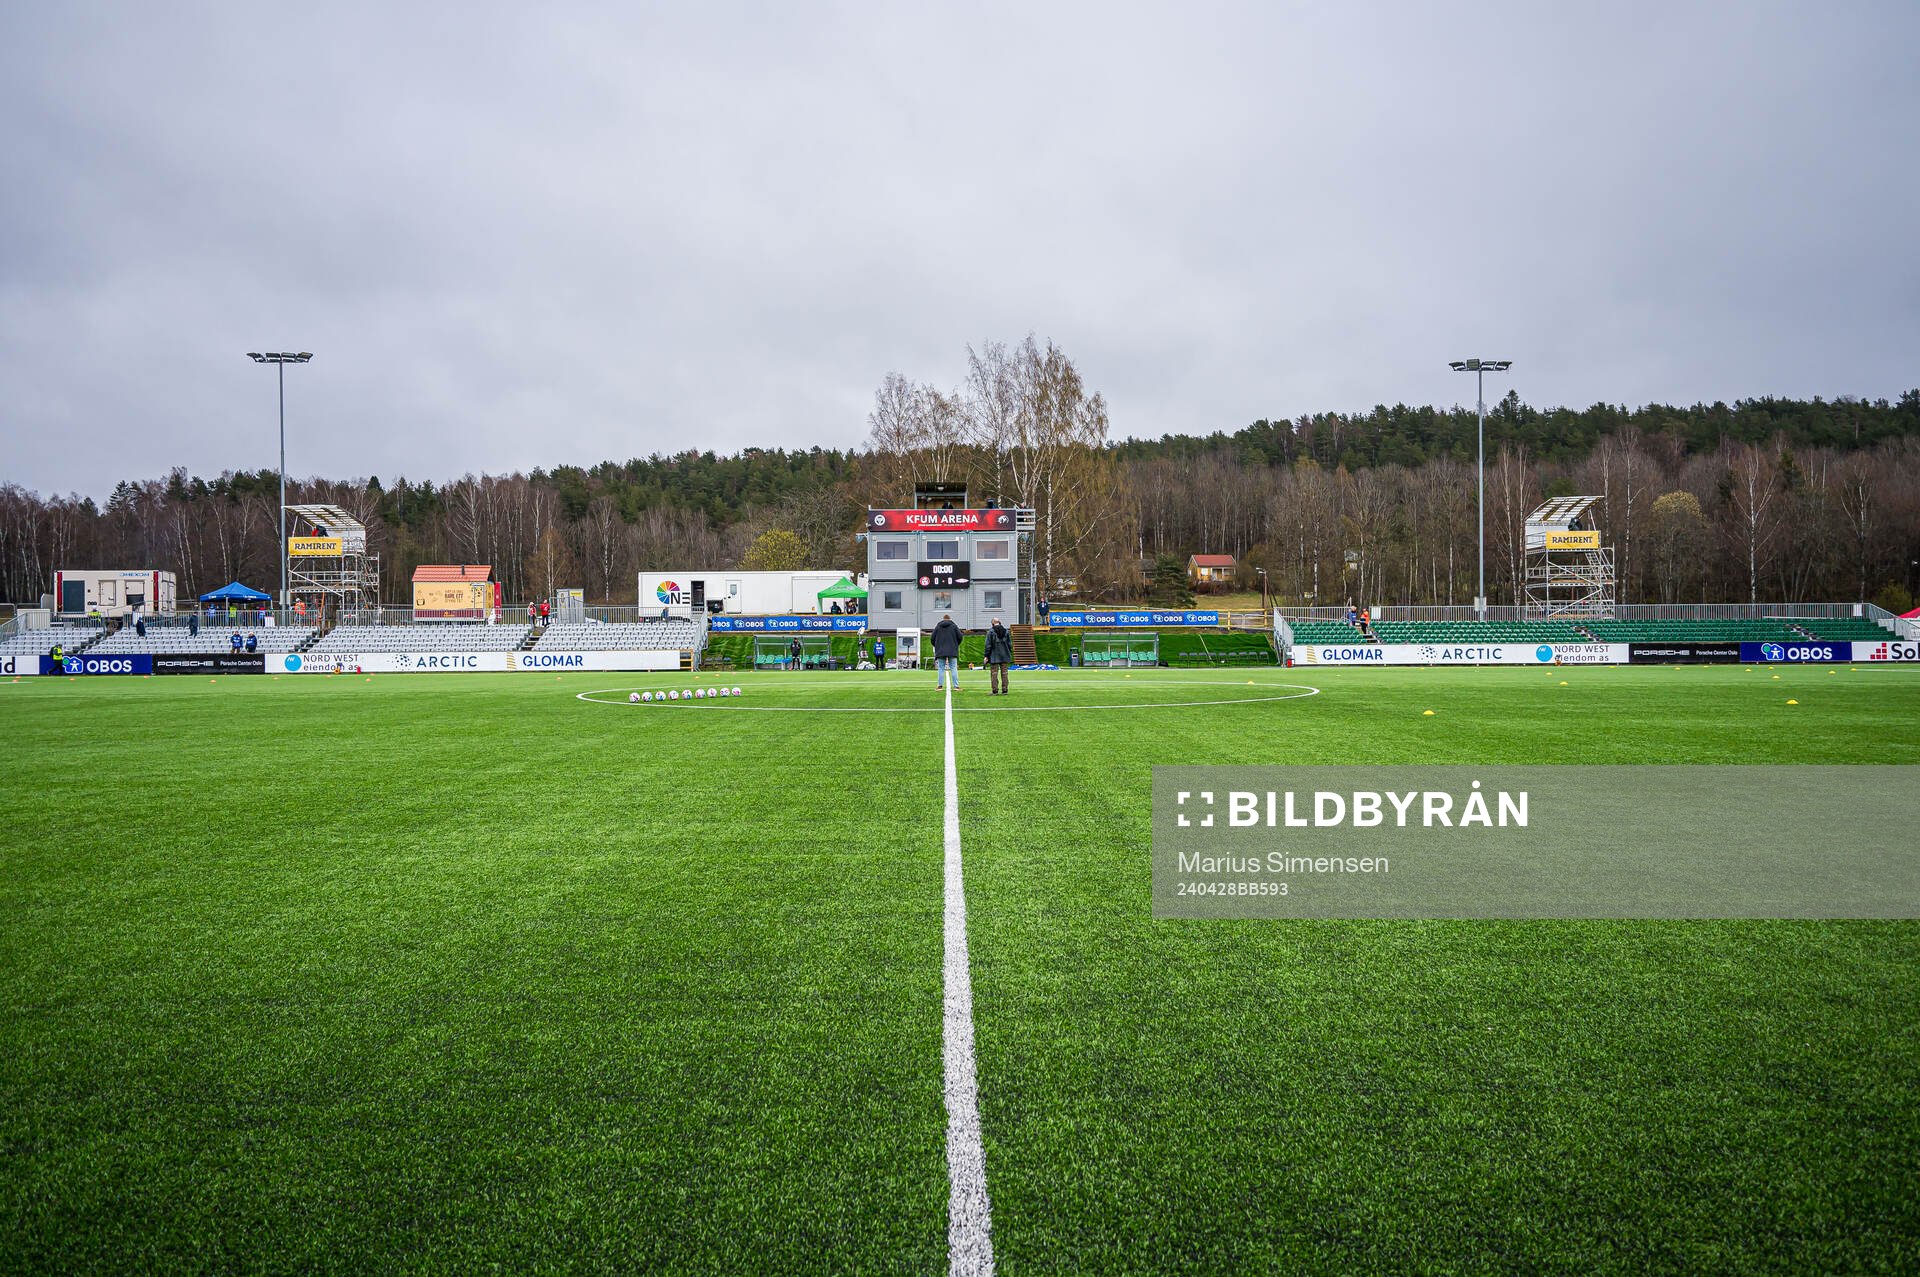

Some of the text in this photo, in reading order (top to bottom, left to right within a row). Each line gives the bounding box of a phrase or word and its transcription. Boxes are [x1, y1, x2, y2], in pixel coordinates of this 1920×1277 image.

[906, 515, 978, 523] KFUM ARENA
[1322, 649, 1383, 660] GLOMAR
[1442, 648, 1502, 660] ARCTIC
[1554, 645, 1582, 653] NORD
[1584, 645, 1610, 653] WEST
[1787, 647, 1832, 660] OBOS
[303, 654, 330, 663] NORD
[333, 654, 359, 662] WEST
[416, 656, 477, 667] ARCTIC
[522, 655, 583, 667] GLOMAR
[86, 660, 132, 672] OBOS
